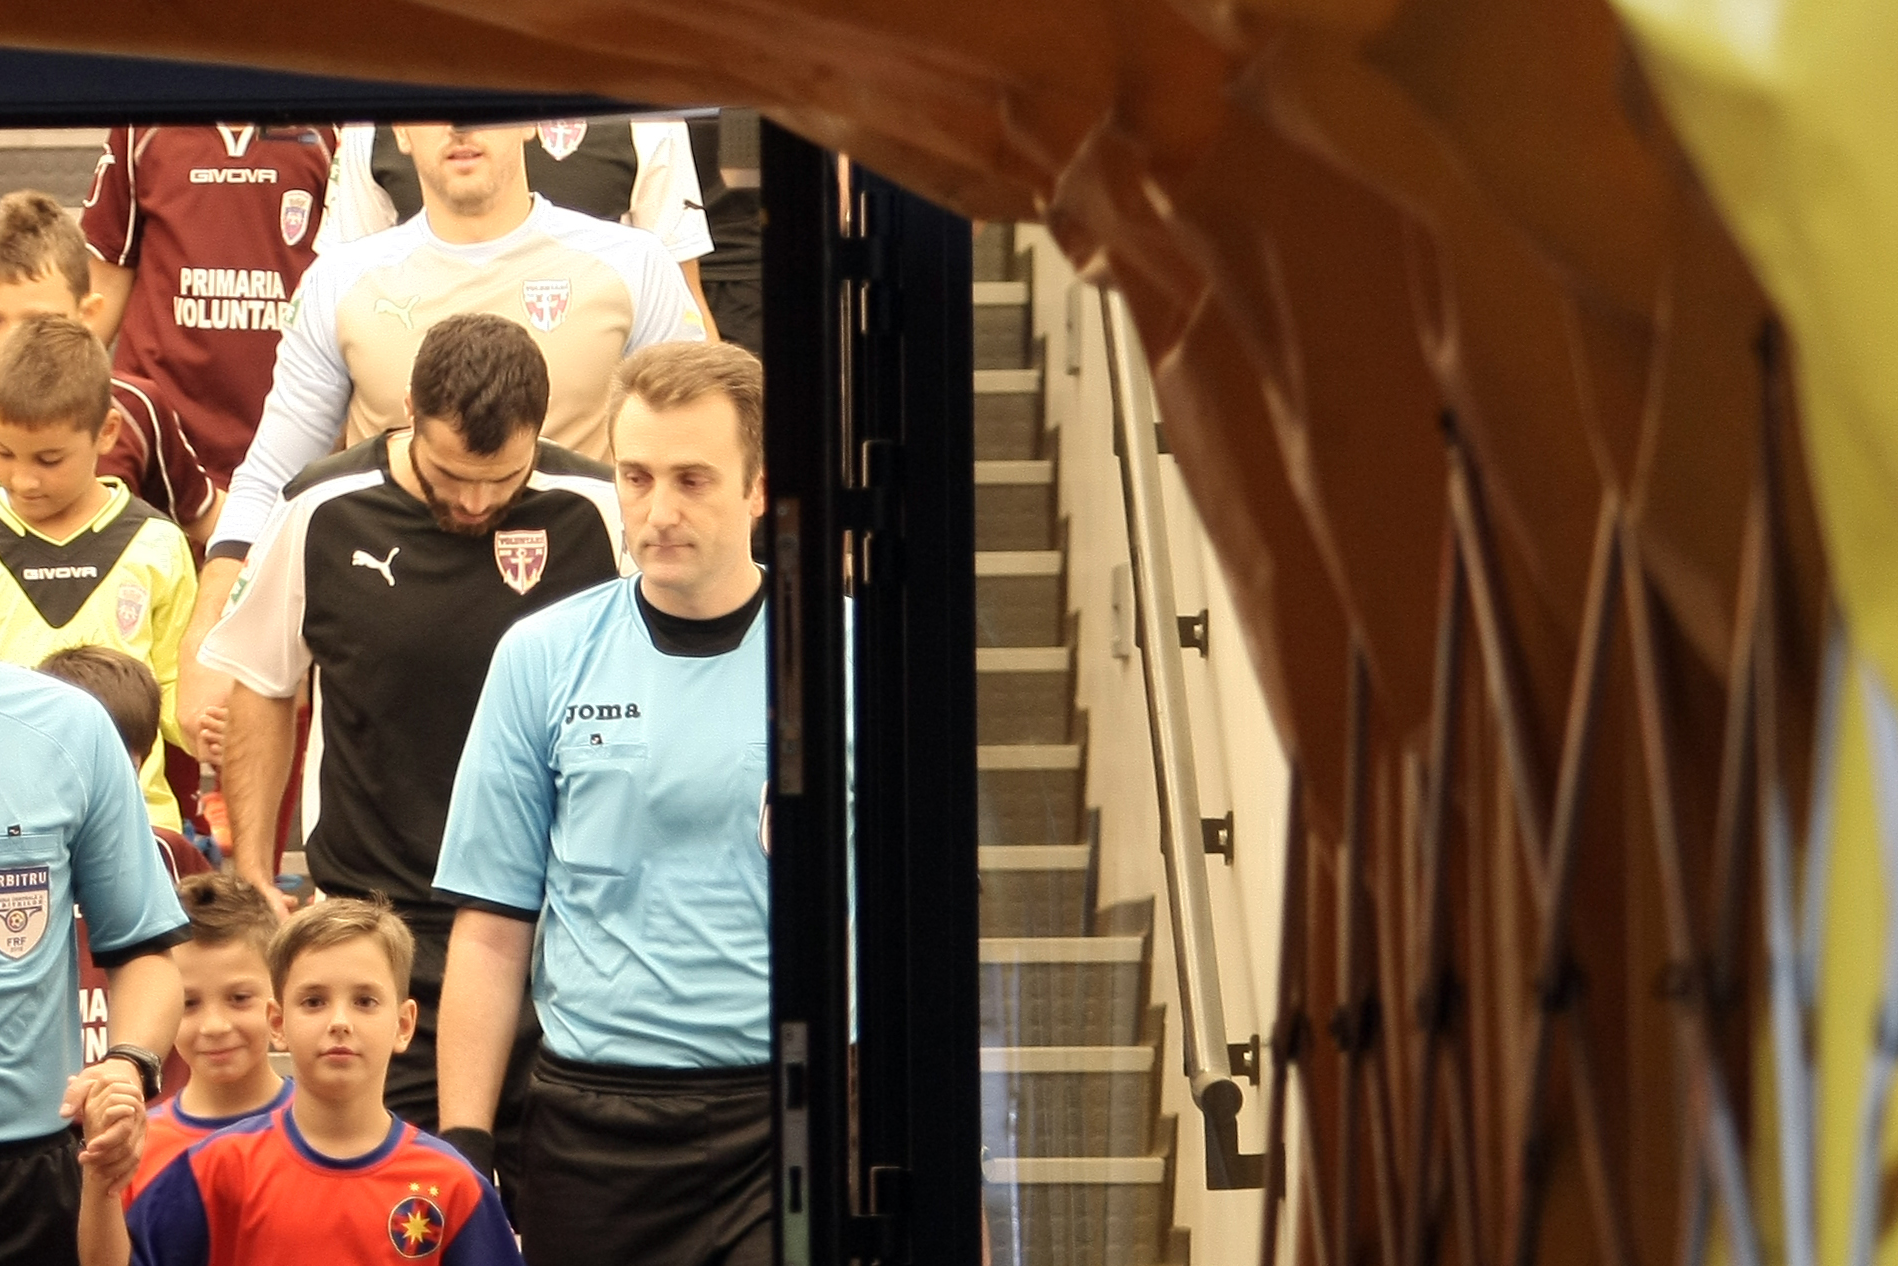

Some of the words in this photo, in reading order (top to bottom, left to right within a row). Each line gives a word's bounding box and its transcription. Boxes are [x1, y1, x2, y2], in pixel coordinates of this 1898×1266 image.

[189, 168, 279, 184] GIVOVA
[179, 267, 287, 299] PRIMARIA
[23, 566, 98, 580] GIVOVA
